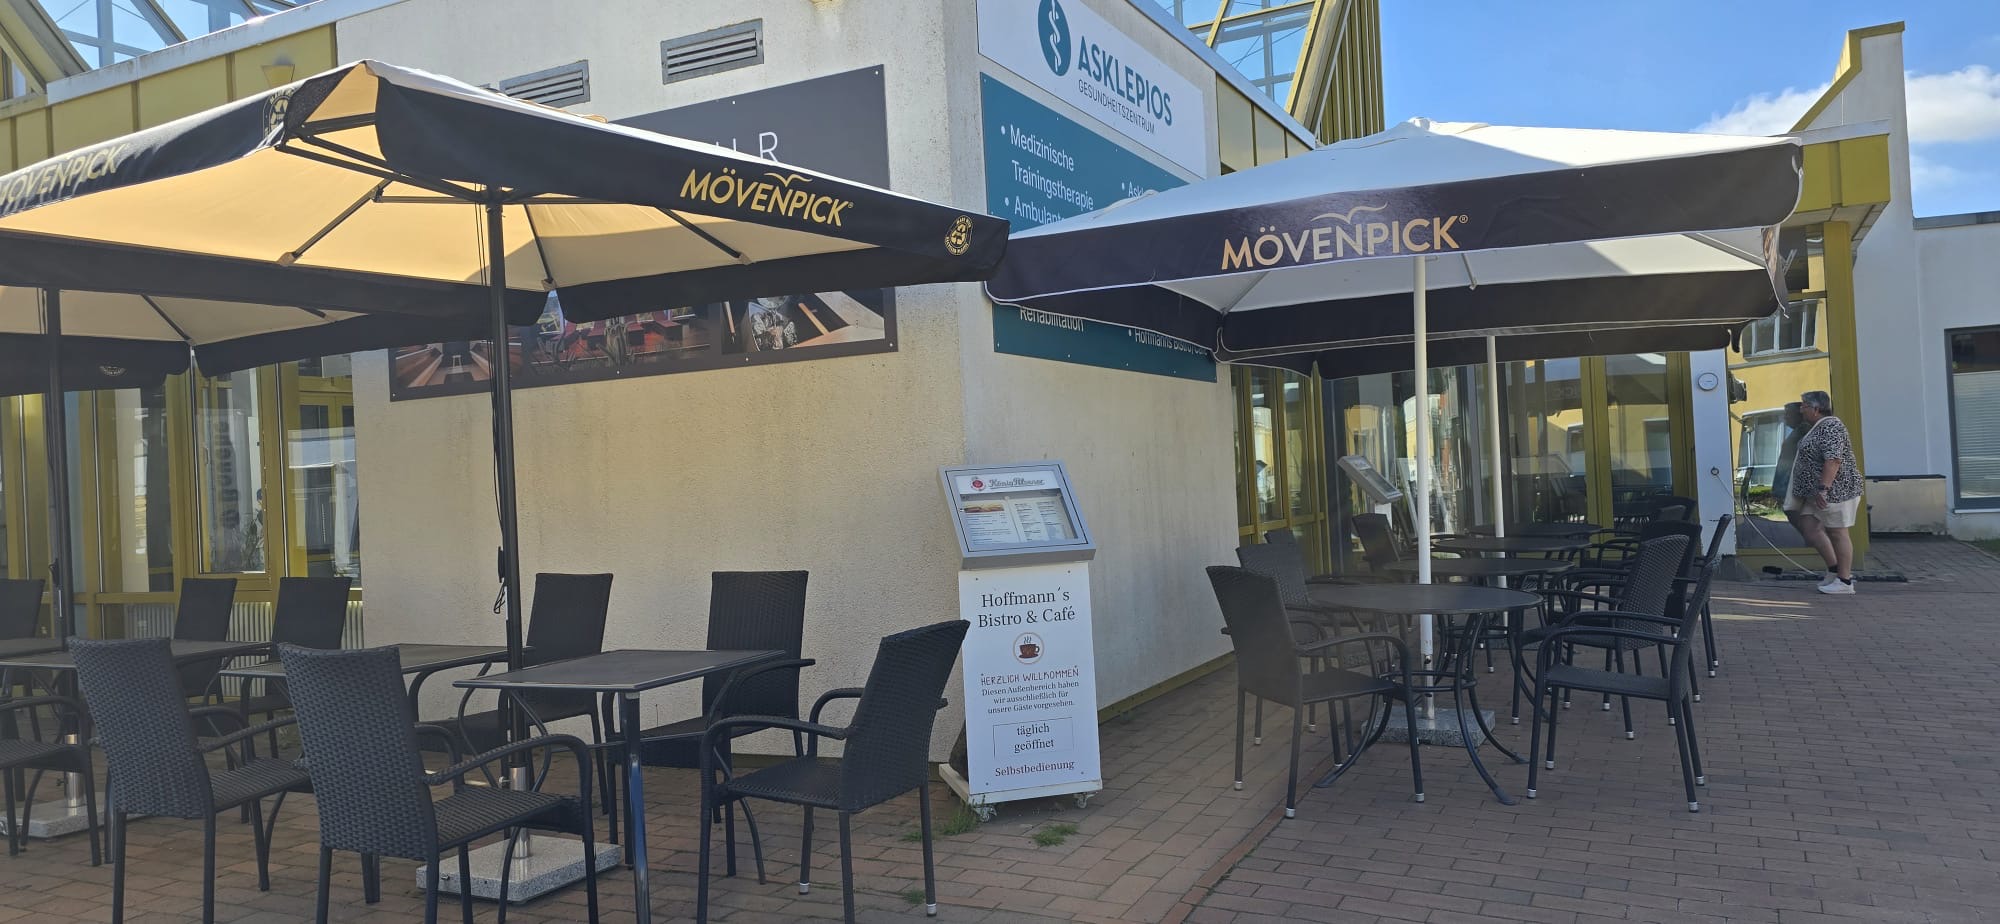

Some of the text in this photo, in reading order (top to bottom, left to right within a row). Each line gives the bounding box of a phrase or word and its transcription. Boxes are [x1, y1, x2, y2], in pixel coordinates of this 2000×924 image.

[1078, 36, 1172, 127] ASKLEPIOS
[1078, 79, 1155, 135] GESUNDHEITSZENTRUM
[1010, 124, 1074, 172] Medizinische
[1012, 160, 1094, 211] Trainingstherapie
[978, 605, 1075, 628] Bistro & Café
[981, 668, 1079, 686] HERZLICH WILLKOMMEN
[982, 680, 1080, 696] Diesen Außenbereich haben
[994, 690, 1069, 704] wir ausschließlich für
[987, 705, 1011, 714] unsere
[1013, 702, 1032, 712] Gäste
[1017, 722, 1050, 737] täglich
[1014, 739, 1054, 754] geöffnet
[995, 761, 1075, 777] Selbstbedienung
